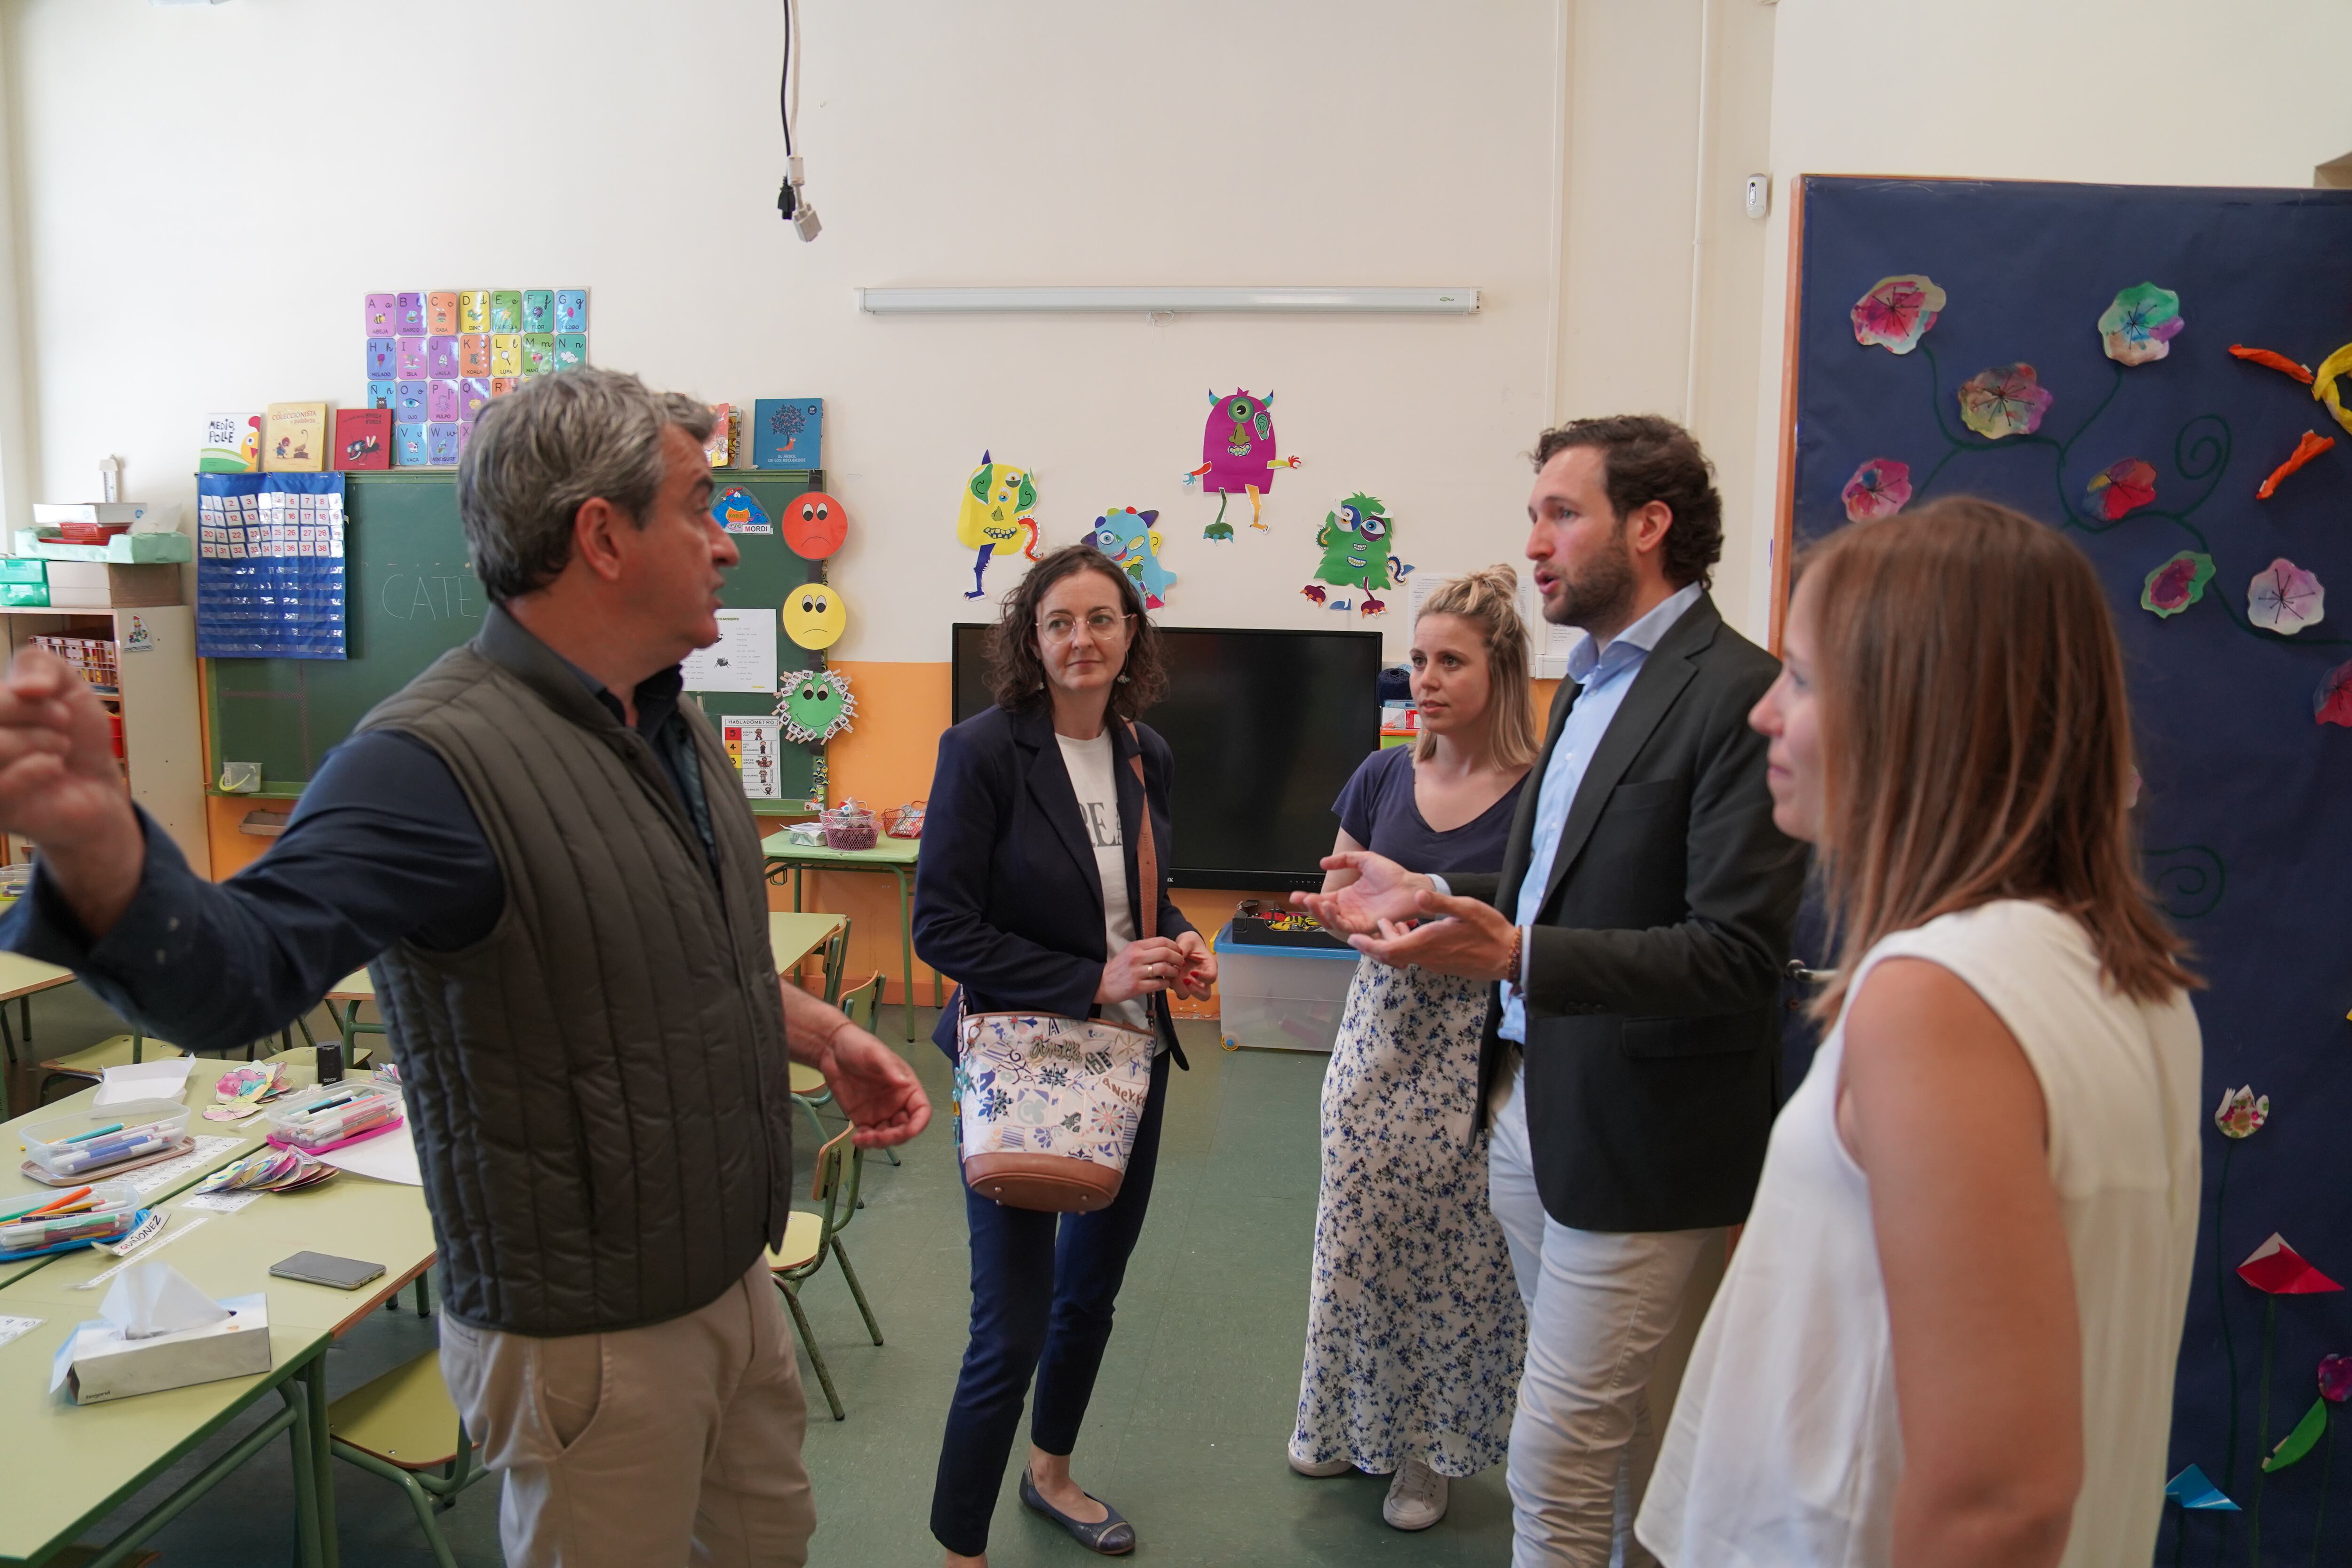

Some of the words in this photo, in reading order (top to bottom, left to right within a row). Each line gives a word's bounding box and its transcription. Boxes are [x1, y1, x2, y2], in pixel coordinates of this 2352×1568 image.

[368, 299, 376, 308] A
[400, 297, 407, 307] B
[431, 297, 438, 306] C
[463, 296, 470, 305] D
[480, 295, 487, 305] d
[496, 295, 502, 304] E
[527, 294, 534, 304] F
[544, 294, 551, 310] f
[559, 294, 566, 304] G
[576, 299, 584, 310] g
[370, 342, 377, 351] H
[386, 342, 393, 352] h
[402, 342, 406, 351] I
[431, 341, 438, 350] J
[463, 339, 470, 349] K
[496, 339, 502, 348] L
[513, 339, 518, 348] l
[526, 338, 534, 347] M
[559, 338, 566, 348] N
[371, 384, 377, 395] Ñ
[400, 385, 408, 395] O
[432, 384, 438, 394] P
[448, 388, 455, 400] p
[462, 383, 470, 393] Q
[495, 382, 502, 392] R
[272, 410, 317, 421] COLECCIONISTA
[401, 428, 408, 437] V
[431, 428, 440, 437] W
[463, 427, 469, 436] X
[120, 1214, 161, 1250] QUIÑONEZ
